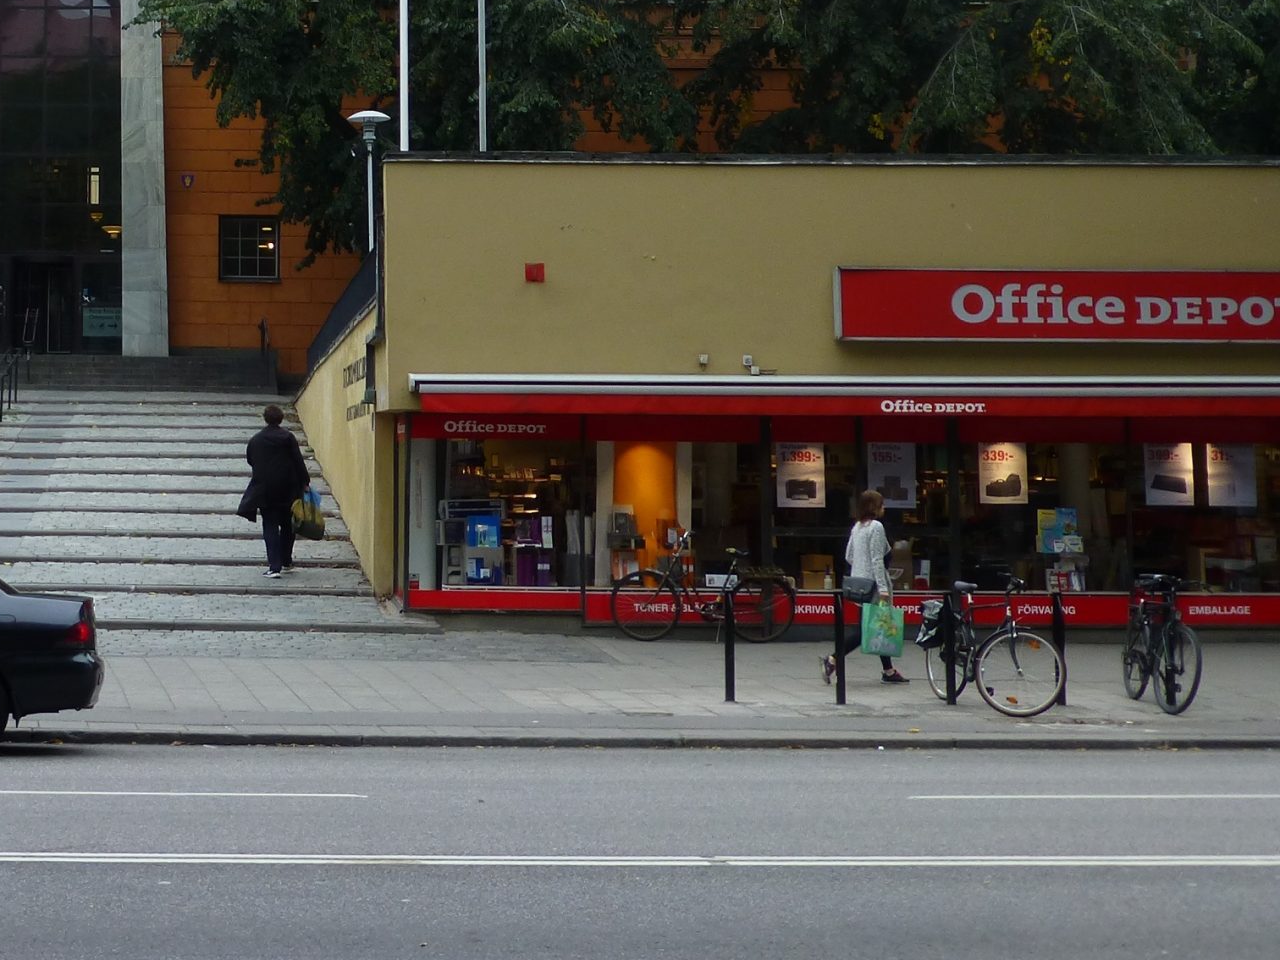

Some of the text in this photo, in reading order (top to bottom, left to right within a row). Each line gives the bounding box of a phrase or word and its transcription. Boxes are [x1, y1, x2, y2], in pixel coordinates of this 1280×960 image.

[950, 283, 1280, 326] Office DEPO
[880, 399, 985, 414] Office DEPOT
[443, 420, 547, 435] Office DEPOT
[633, 603, 669, 613] TONER
[794, 604, 835, 615] SKRIVAR
[1017, 603, 1077, 616] FÖRVANG
[1189, 605, 1252, 616] EMBALLAGE
